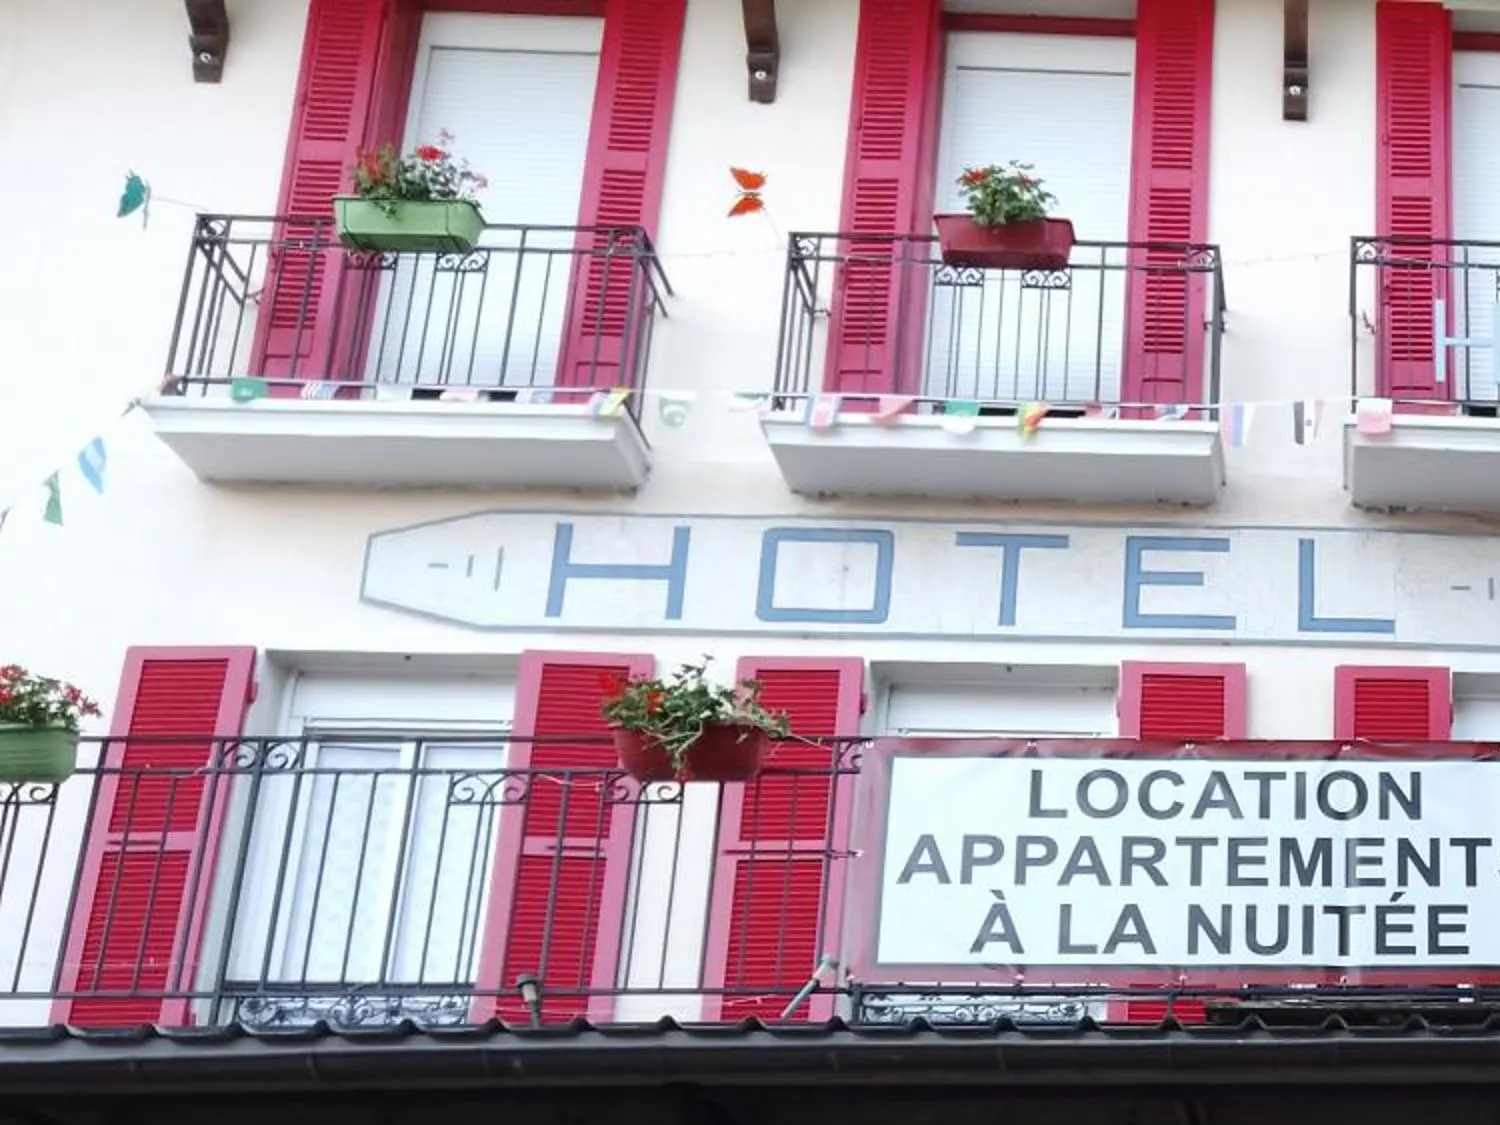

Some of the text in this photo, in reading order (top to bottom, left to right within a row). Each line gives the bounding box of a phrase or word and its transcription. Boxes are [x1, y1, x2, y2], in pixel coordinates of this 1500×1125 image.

[543, 522, 1396, 634] HOTEL
[1028, 769, 1423, 821] LOCATION
[969, 890, 1471, 956] À LA NUITÉE
